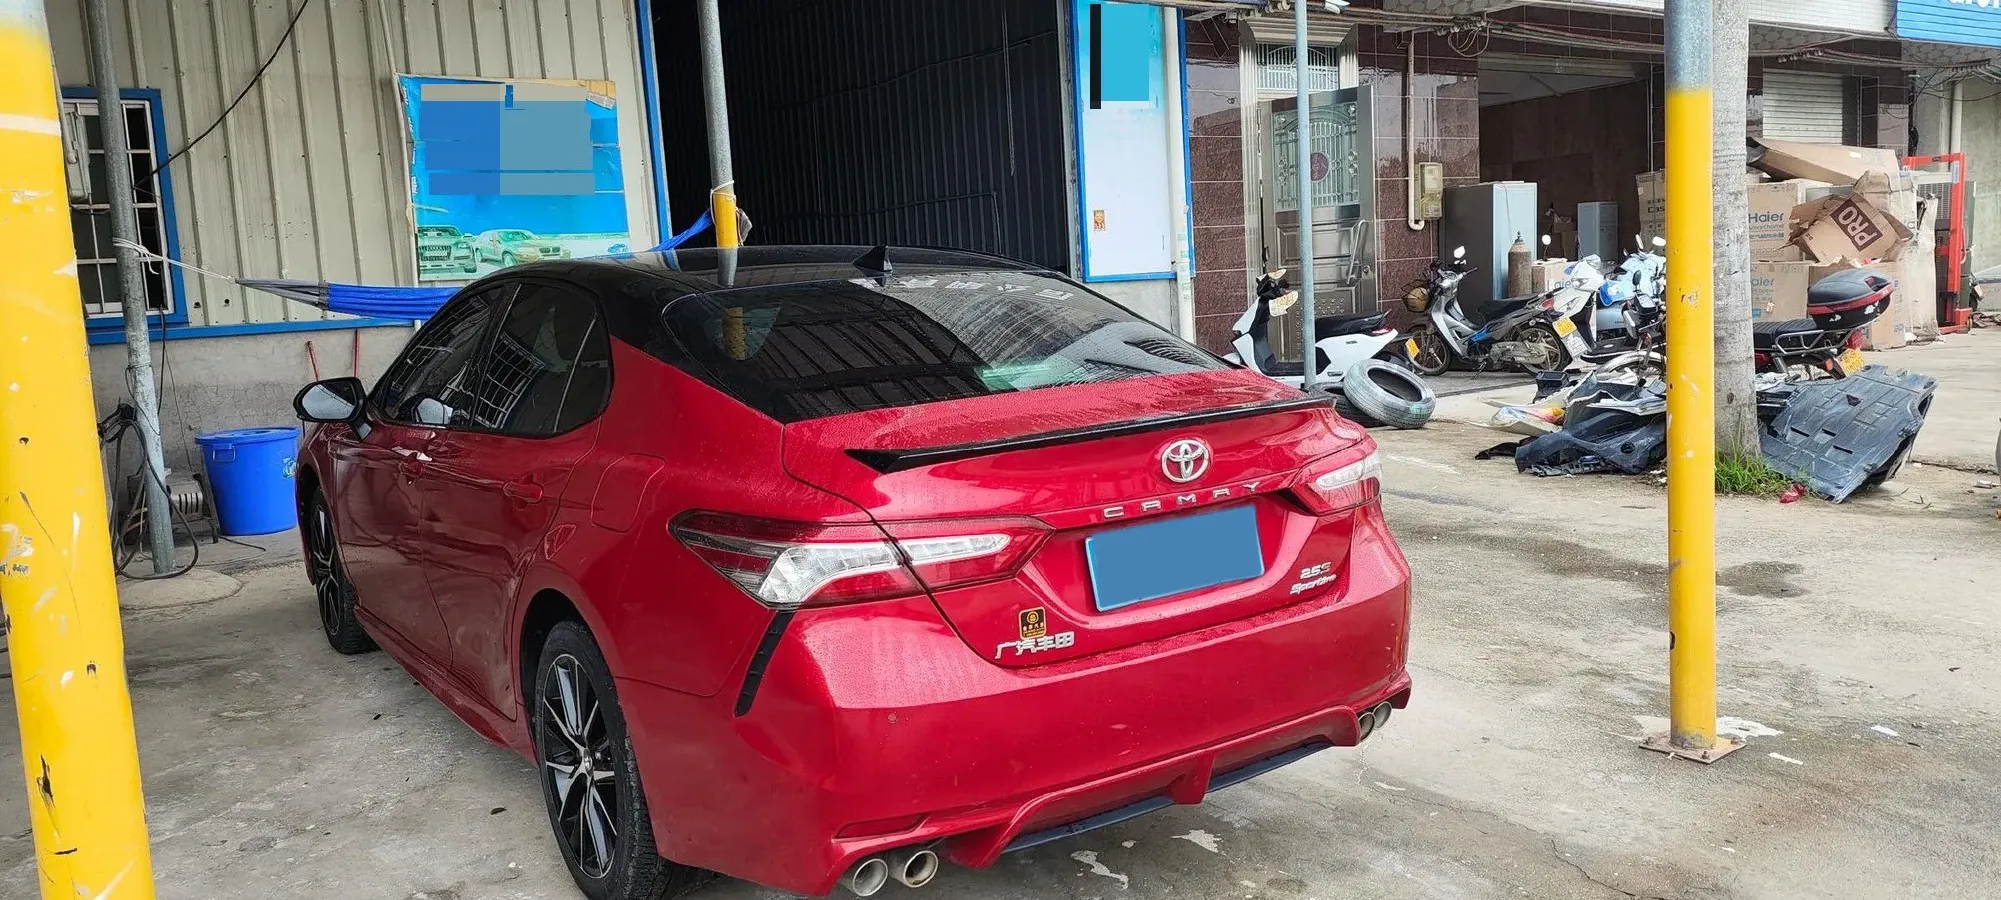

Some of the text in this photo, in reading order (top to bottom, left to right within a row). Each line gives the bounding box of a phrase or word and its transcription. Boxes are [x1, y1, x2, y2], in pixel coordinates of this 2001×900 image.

[1748, 211, 1784, 223] Haier
[1838, 206, 1878, 246] PRO
[1751, 277, 1774, 287] aier
[1103, 481, 1260, 518] CAMRY
[994, 631, 1075, 660] 广汽丰田
